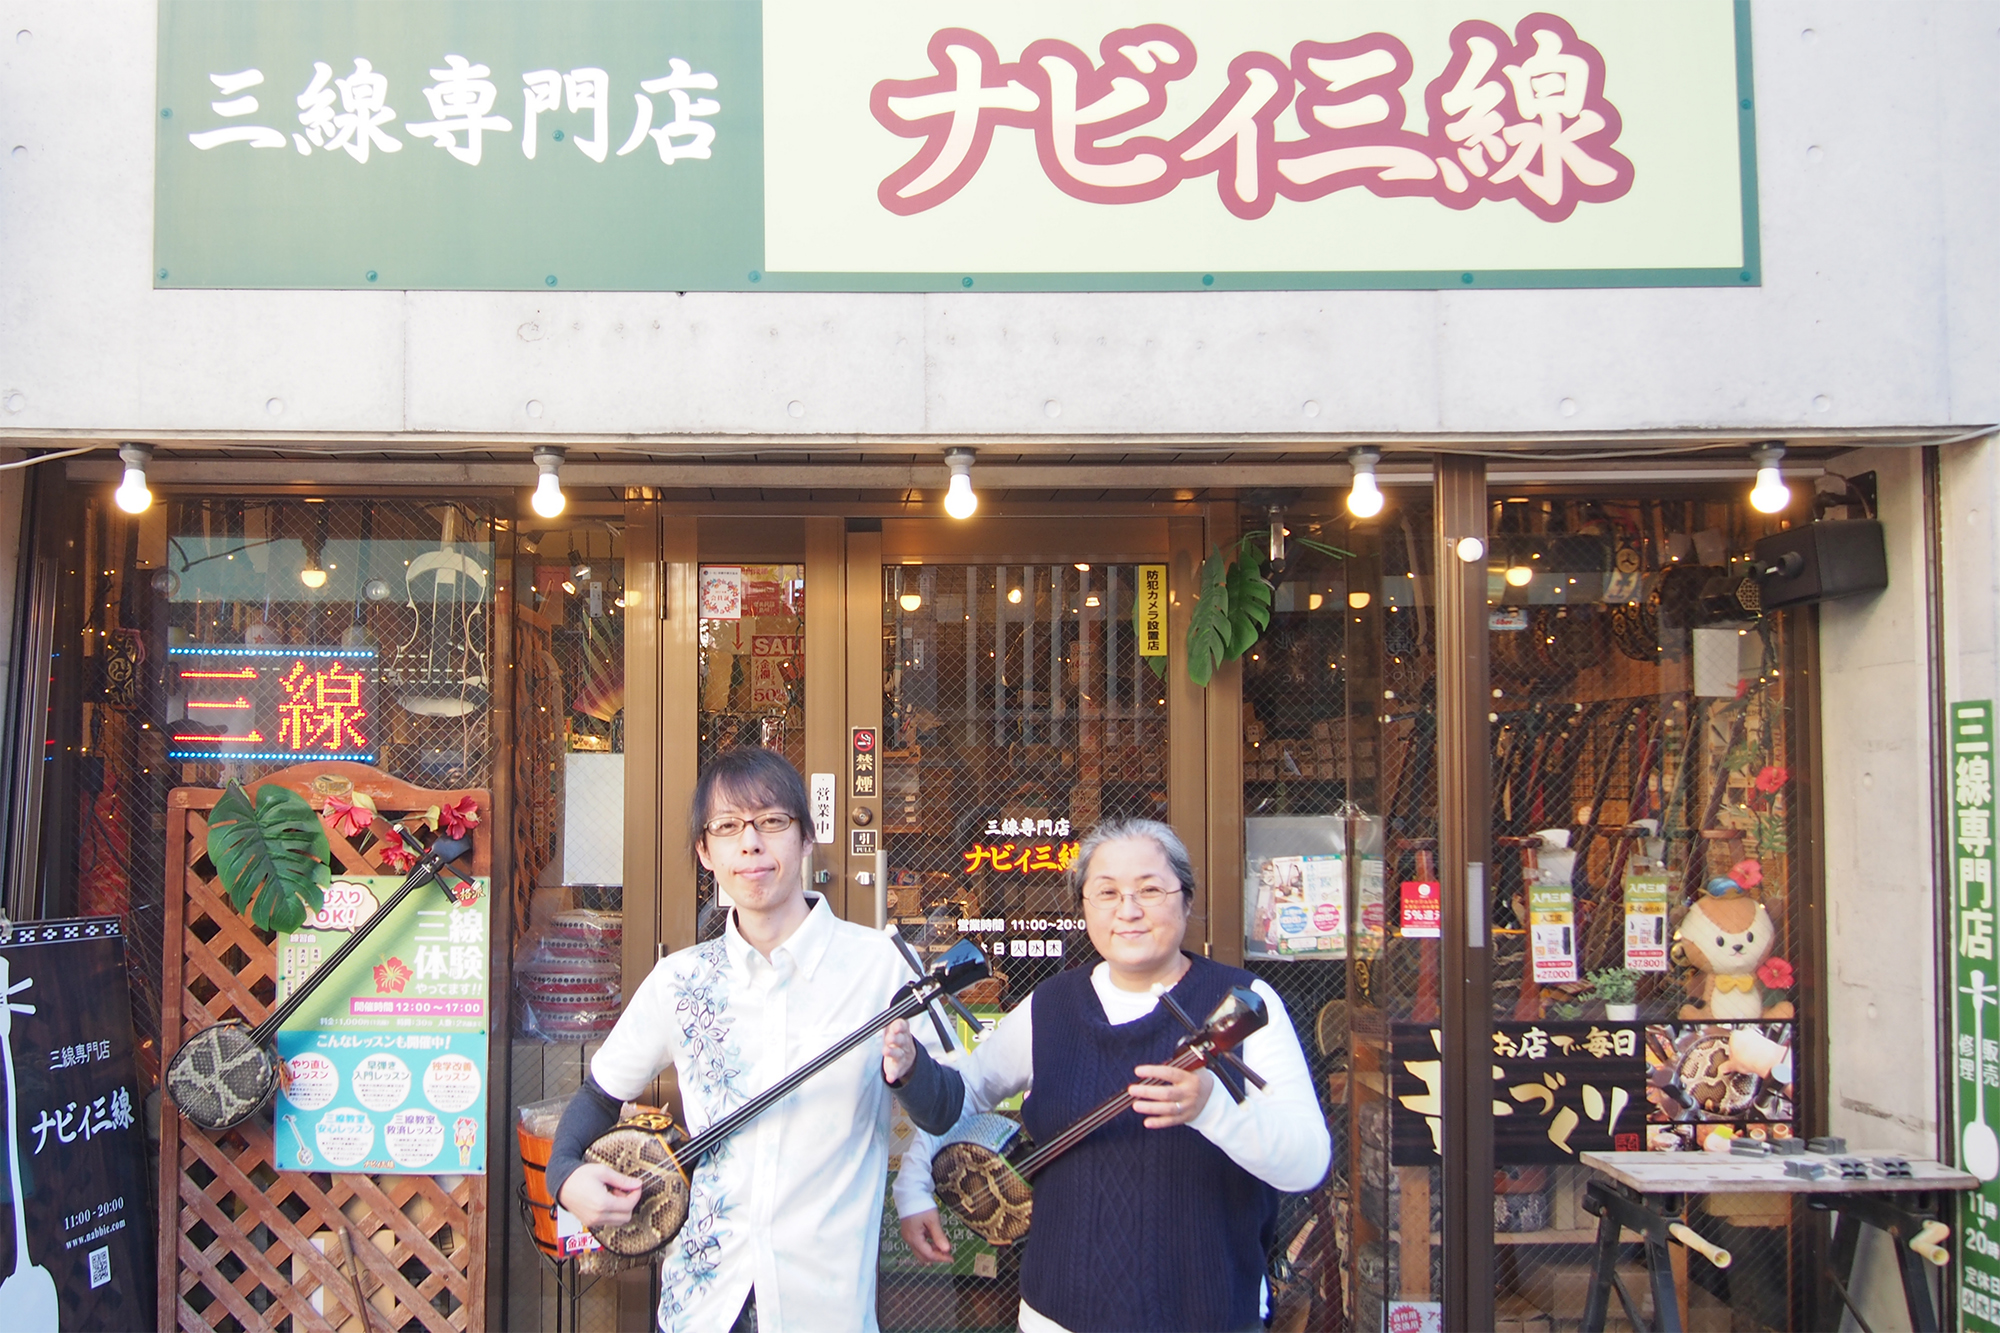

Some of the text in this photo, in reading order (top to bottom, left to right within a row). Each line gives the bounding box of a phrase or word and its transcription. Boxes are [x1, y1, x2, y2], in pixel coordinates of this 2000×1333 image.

[188, 54, 721, 166] 三線専門店
[1147, 570, 1159, 650] 防犯カメラ設置店
[174, 661, 367, 749] 三線
[855, 753, 873, 793] 禁煙
[817, 787, 830, 834] 営業中
[859, 833, 870, 845] 引
[984, 817, 1070, 837] 三線専門店
[1956, 707, 1993, 960] 三線専門店
[316, 909, 355, 923] OK!
[414, 909, 484, 944] 三線
[957, 919, 1086, 932] 営業時間 11:00~20:0
[413, 945, 484, 980] 体験
[415, 983, 482, 996] やってます!!
[354, 1002, 393, 1012] 開催時間
[49, 1039, 111, 1070] 三線専門店
[317, 1034, 452, 1050] こんなレッスンも開催中!
[291, 1060, 329, 1070] やり直し
[367, 1061, 396, 1070] 早弾き
[1958, 1034, 1974, 1081] 修理
[1982, 1038, 1999, 1087] 販売
[292, 1071, 329, 1080] レッスン
[354, 1072, 410, 1081] 入門レッスン
[435, 1073, 470, 1081] レッスン
[66, 1218, 126, 1250] www.nabbie.com
